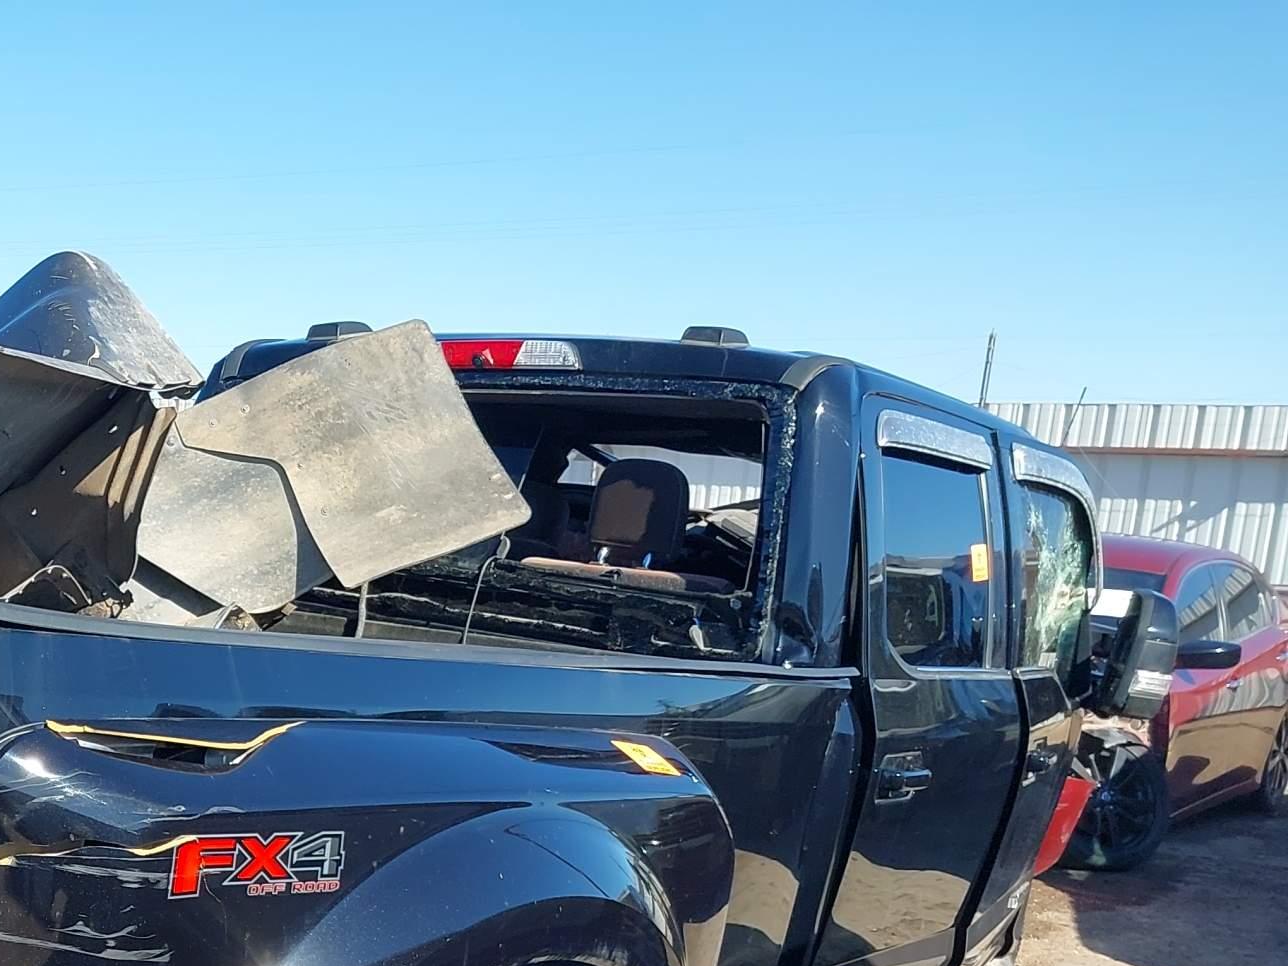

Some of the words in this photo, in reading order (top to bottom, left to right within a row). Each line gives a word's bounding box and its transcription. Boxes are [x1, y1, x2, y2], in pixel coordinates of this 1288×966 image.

[168, 831, 346, 900] FX4
[246, 882, 287, 897] OFF
[290, 880, 340, 895] ROAD
